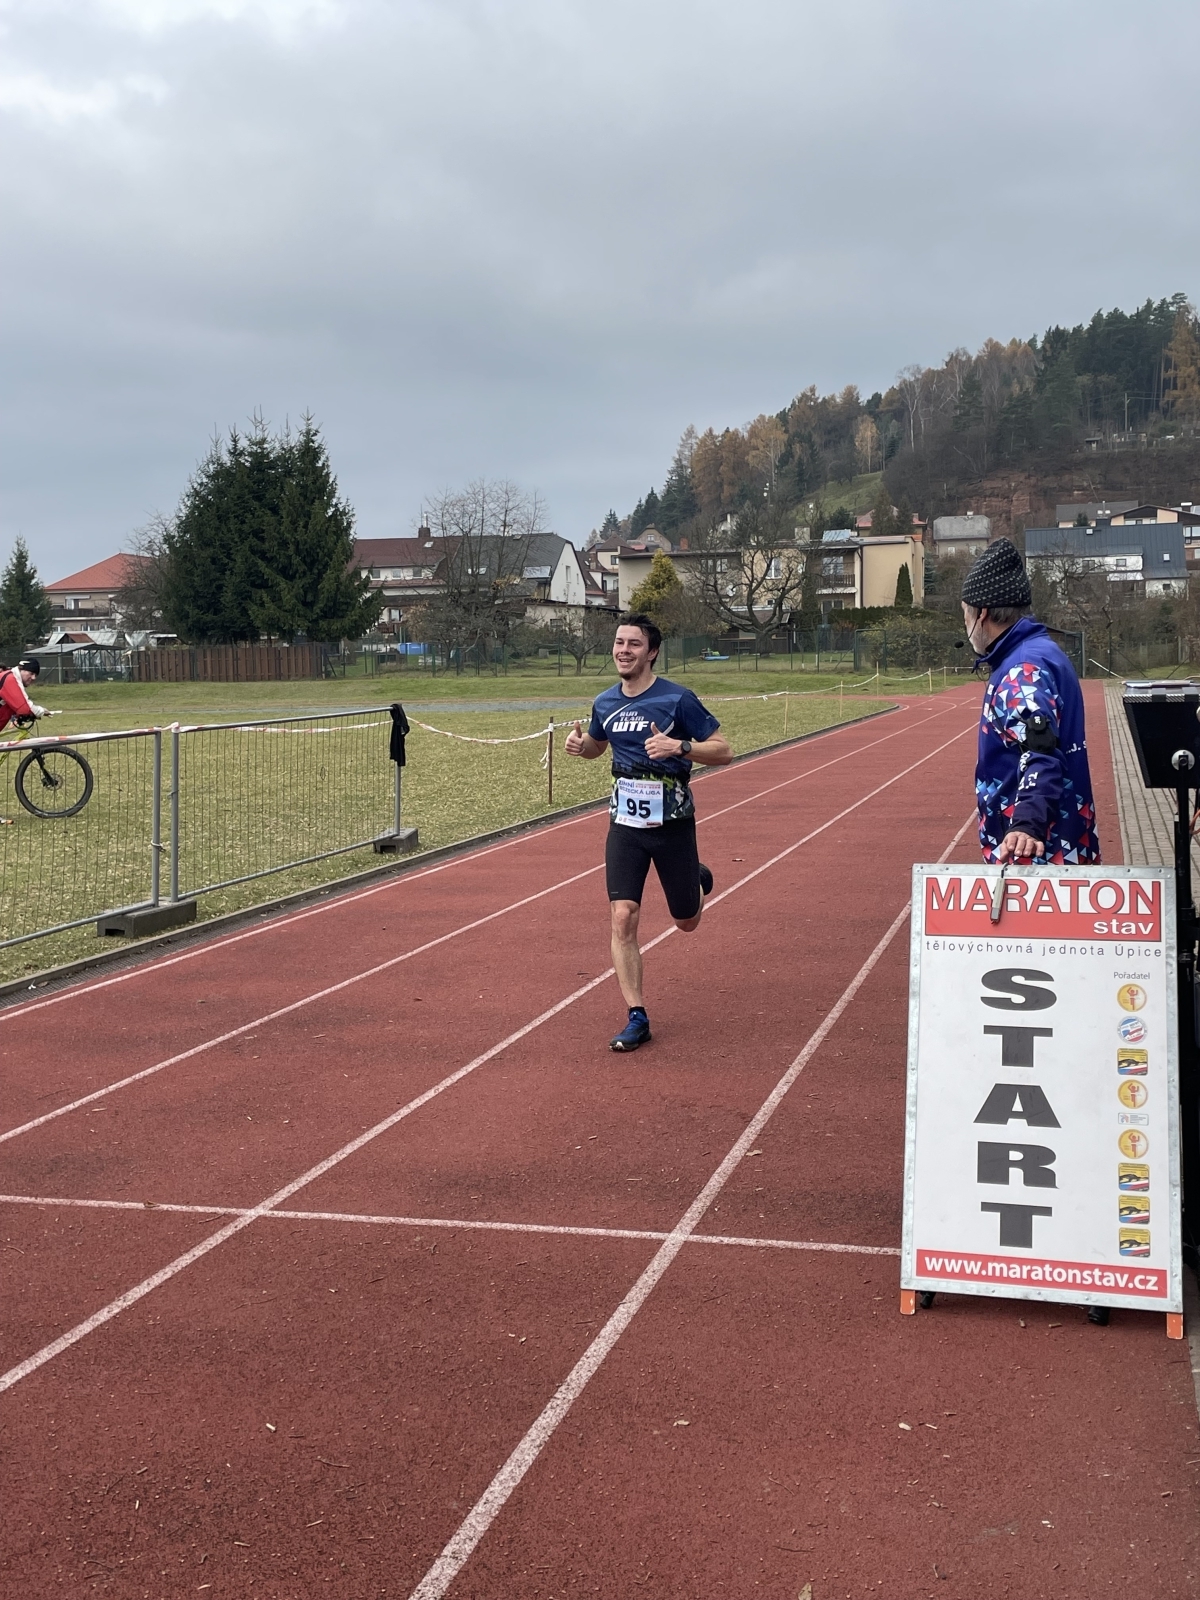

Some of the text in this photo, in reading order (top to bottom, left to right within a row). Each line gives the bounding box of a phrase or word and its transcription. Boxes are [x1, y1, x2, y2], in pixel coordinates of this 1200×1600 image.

[612, 721, 649, 732] WTF
[626, 798, 651, 819] 95
[925, 877, 1161, 914] MARATON
[1093, 918, 1154, 935] stav
[926, 940, 1161, 958] tělovýchovná jednota Úpice
[1113, 971, 1150, 980] Pořadatel
[973, 968, 1062, 1249] START
[924, 1256, 1158, 1290] www.maratonstav.cz
